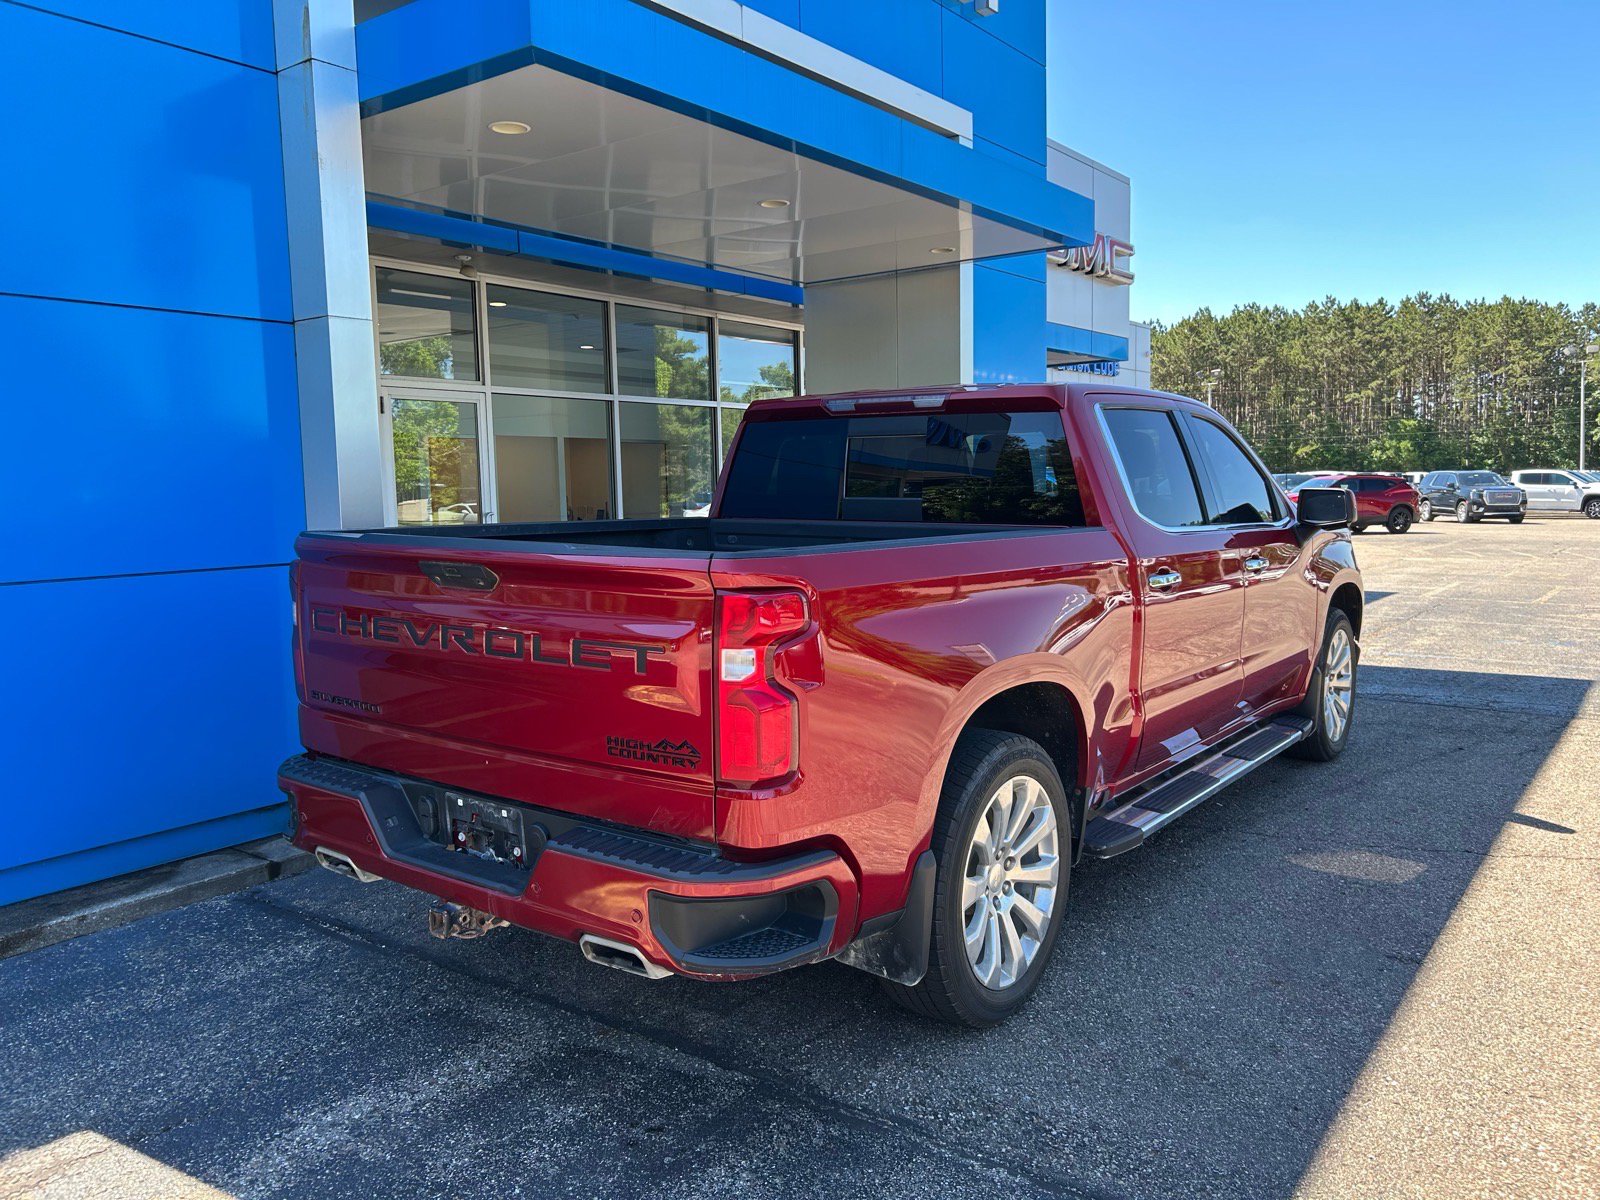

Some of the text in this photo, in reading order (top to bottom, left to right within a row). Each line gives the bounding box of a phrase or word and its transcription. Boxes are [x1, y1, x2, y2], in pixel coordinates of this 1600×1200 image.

[312, 607, 666, 676] CHEVROLET
[606, 735, 652, 752] HIGH
[607, 746, 702, 769] COUNTRY
